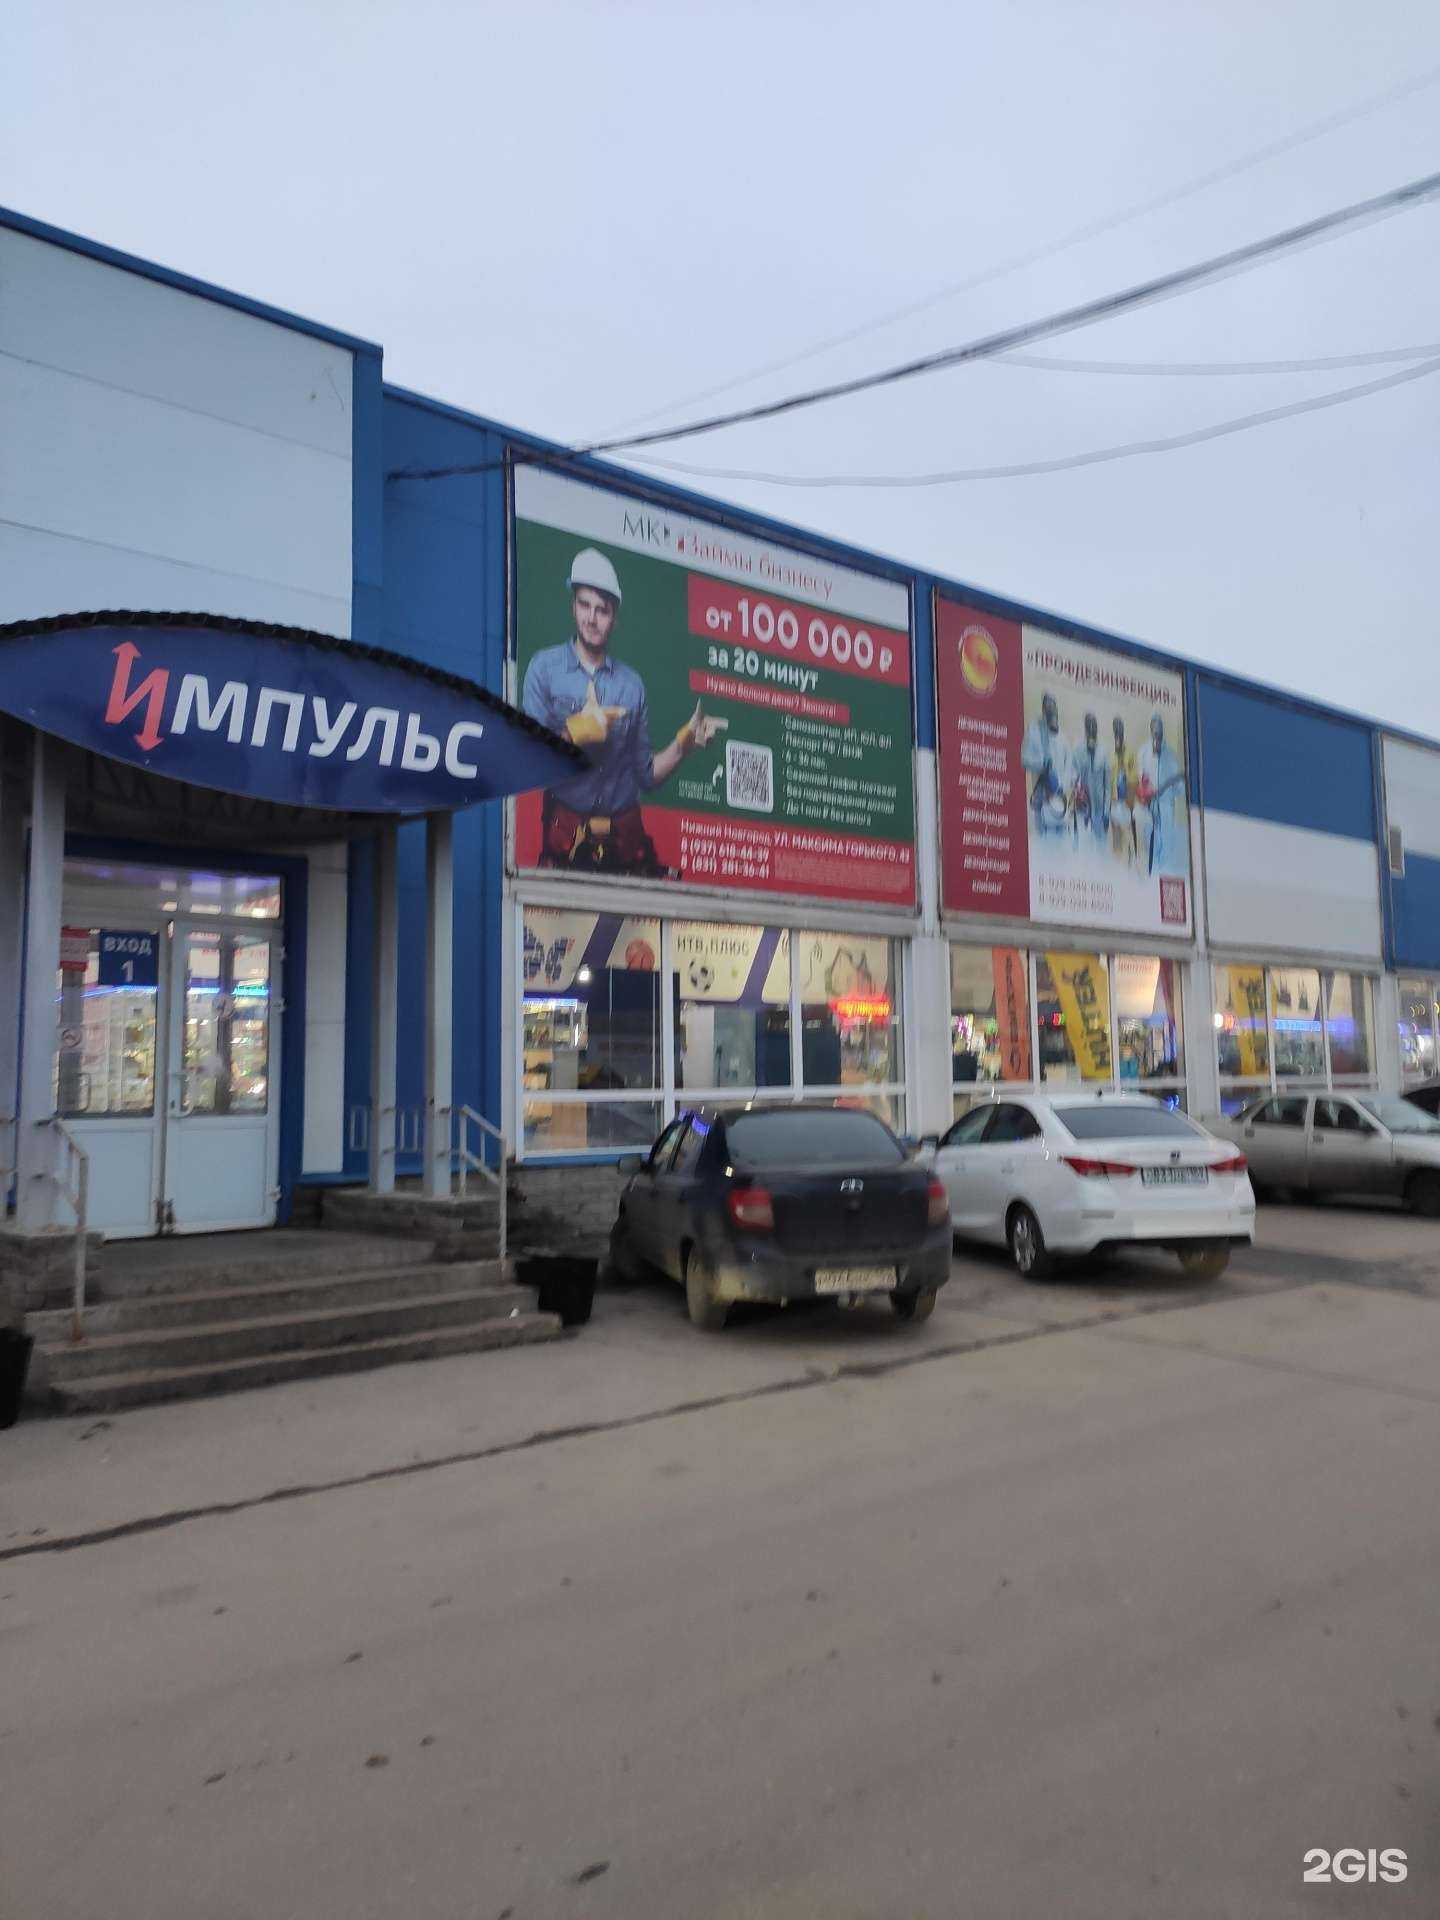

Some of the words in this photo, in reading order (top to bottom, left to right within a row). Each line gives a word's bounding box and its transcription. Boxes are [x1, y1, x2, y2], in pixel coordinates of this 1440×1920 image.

[706, 606, 732, 632] от
[738, 598, 799, 649] 100
[808, 618, 874, 669] 000
[708, 646, 728, 669] за
[734, 647, 759, 676] 20
[764, 660, 819, 692] минут
[706, 676, 737, 697] Нужно
[104, 641, 484, 779] ИМПУЛЬС
[103, 936, 152, 955] ВХОД
[121, 960, 134, 982] 1
